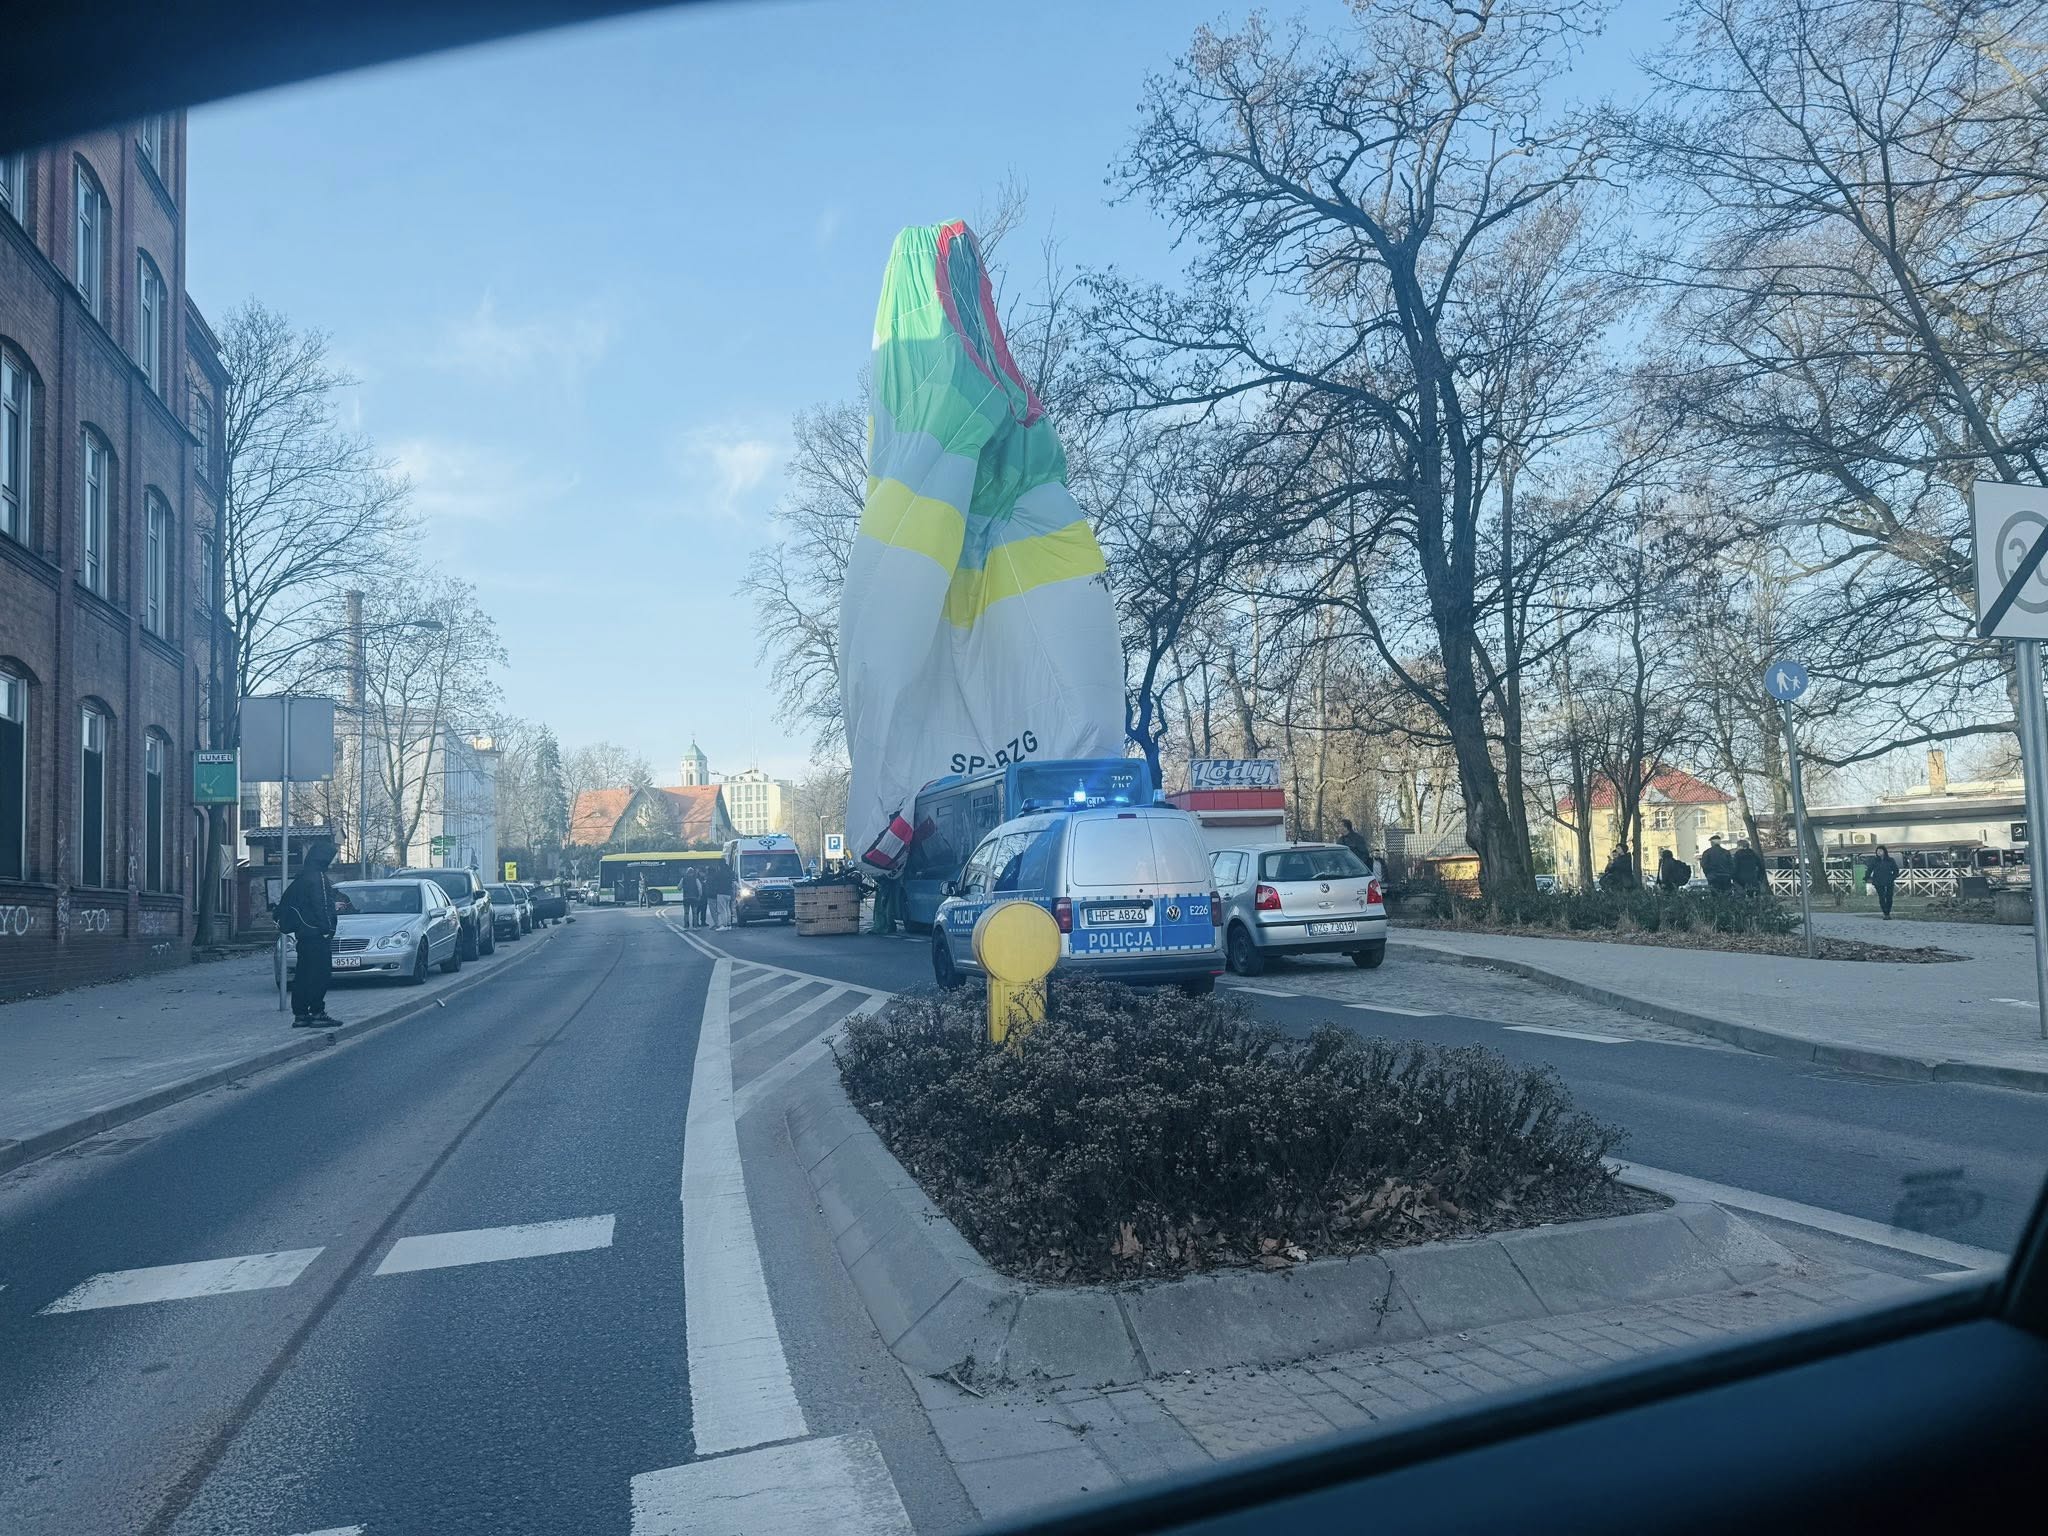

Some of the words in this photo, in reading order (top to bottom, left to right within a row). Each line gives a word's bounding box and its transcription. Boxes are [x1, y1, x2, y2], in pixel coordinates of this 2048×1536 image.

[1192, 760, 1273, 784] Lody
[1094, 910, 1116, 921] HPE
[1118, 909, 1144, 920] A826
[1189, 905, 1209, 916] E226
[1312, 923, 1329, 933] DZG
[1088, 931, 1154, 948] POLICJA
